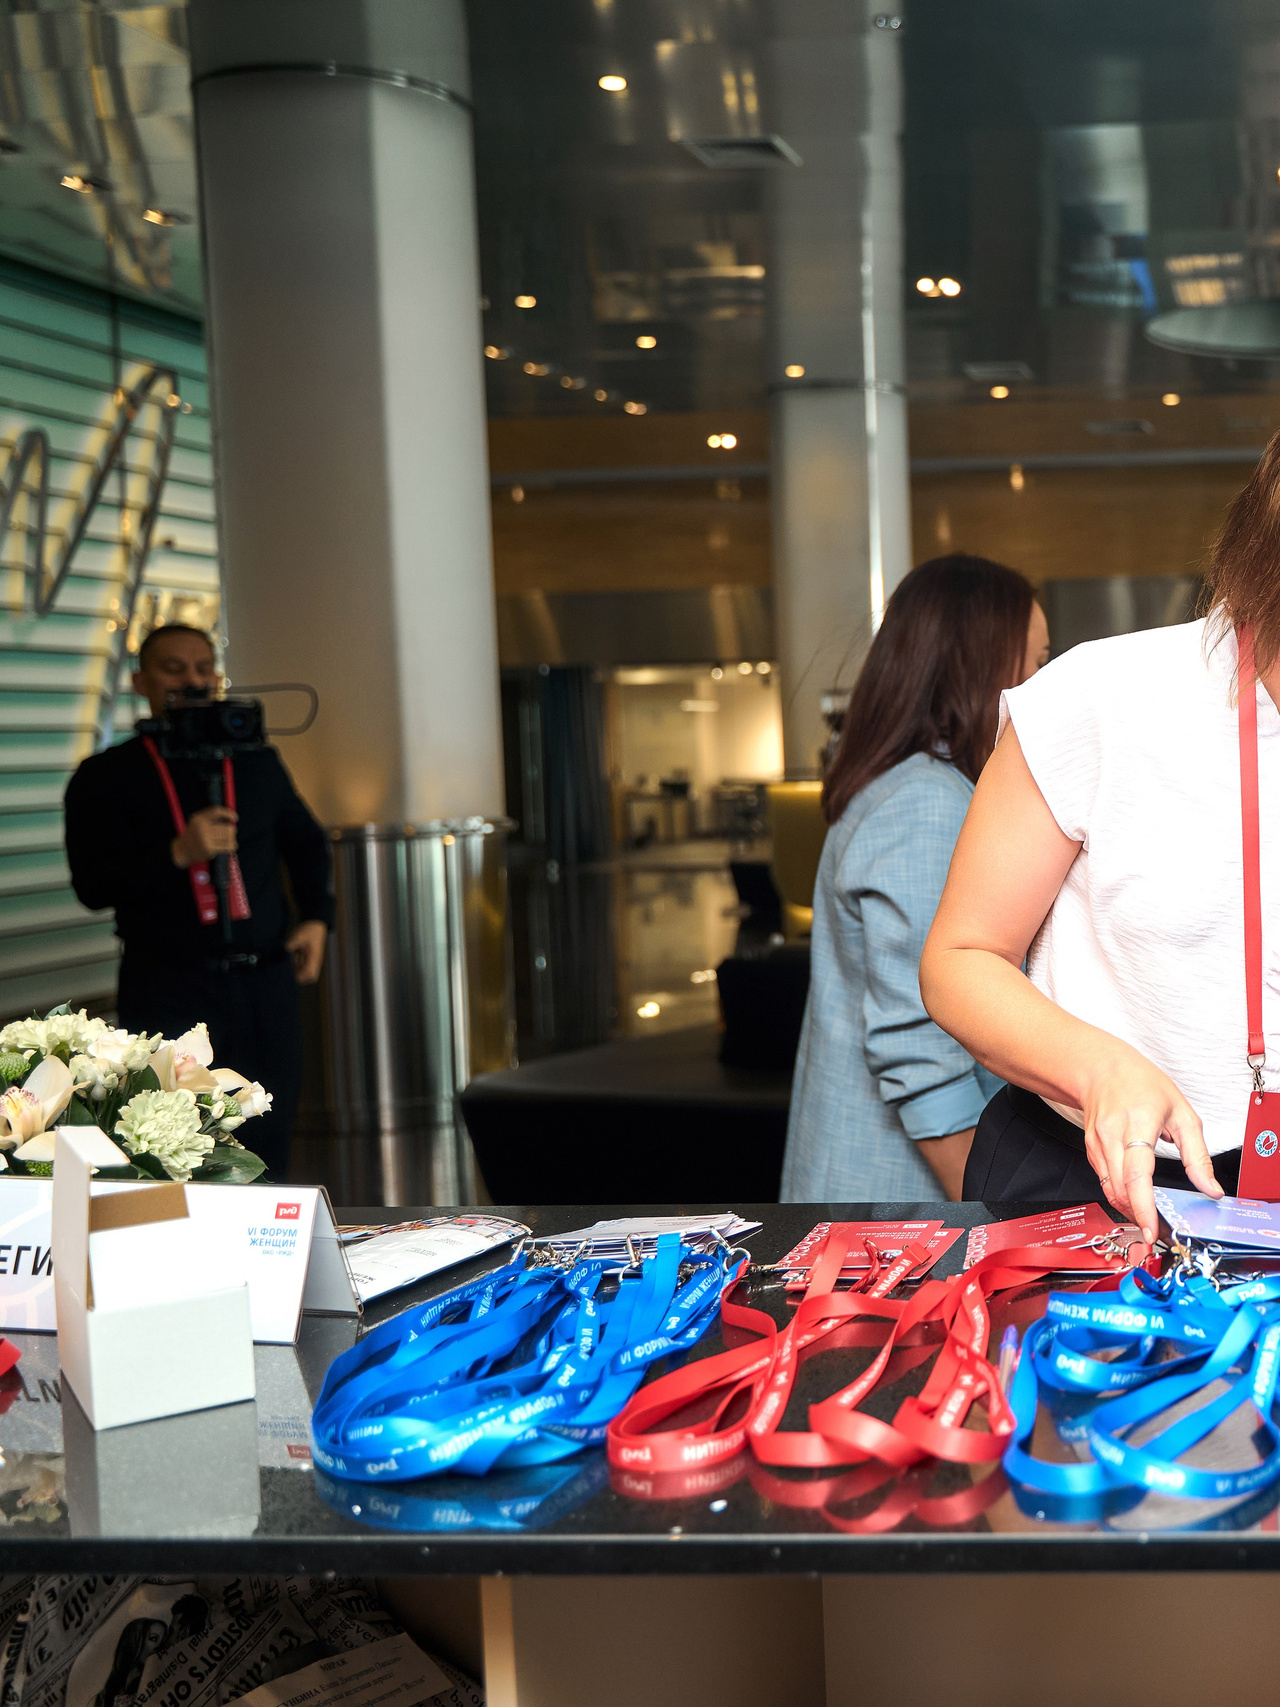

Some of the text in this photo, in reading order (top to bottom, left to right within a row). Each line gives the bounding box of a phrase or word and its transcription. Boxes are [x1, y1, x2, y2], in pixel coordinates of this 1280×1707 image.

[247, 1227, 298, 1237] VI ФОРУМ
[249, 1238, 296, 1248] ЖЕНЩИН
[878, 1259, 912, 1291] VI ФОРУМ
[420, 1293, 461, 1328] ЖЕНЩИН
[1092, 1308, 1147, 1327] ФОРУМ
[1151, 1315, 1165, 1329] VI
[620, 1337, 669, 1365] VI ФОРУМ
[508, 1395, 557, 1424] ФОРУМ
